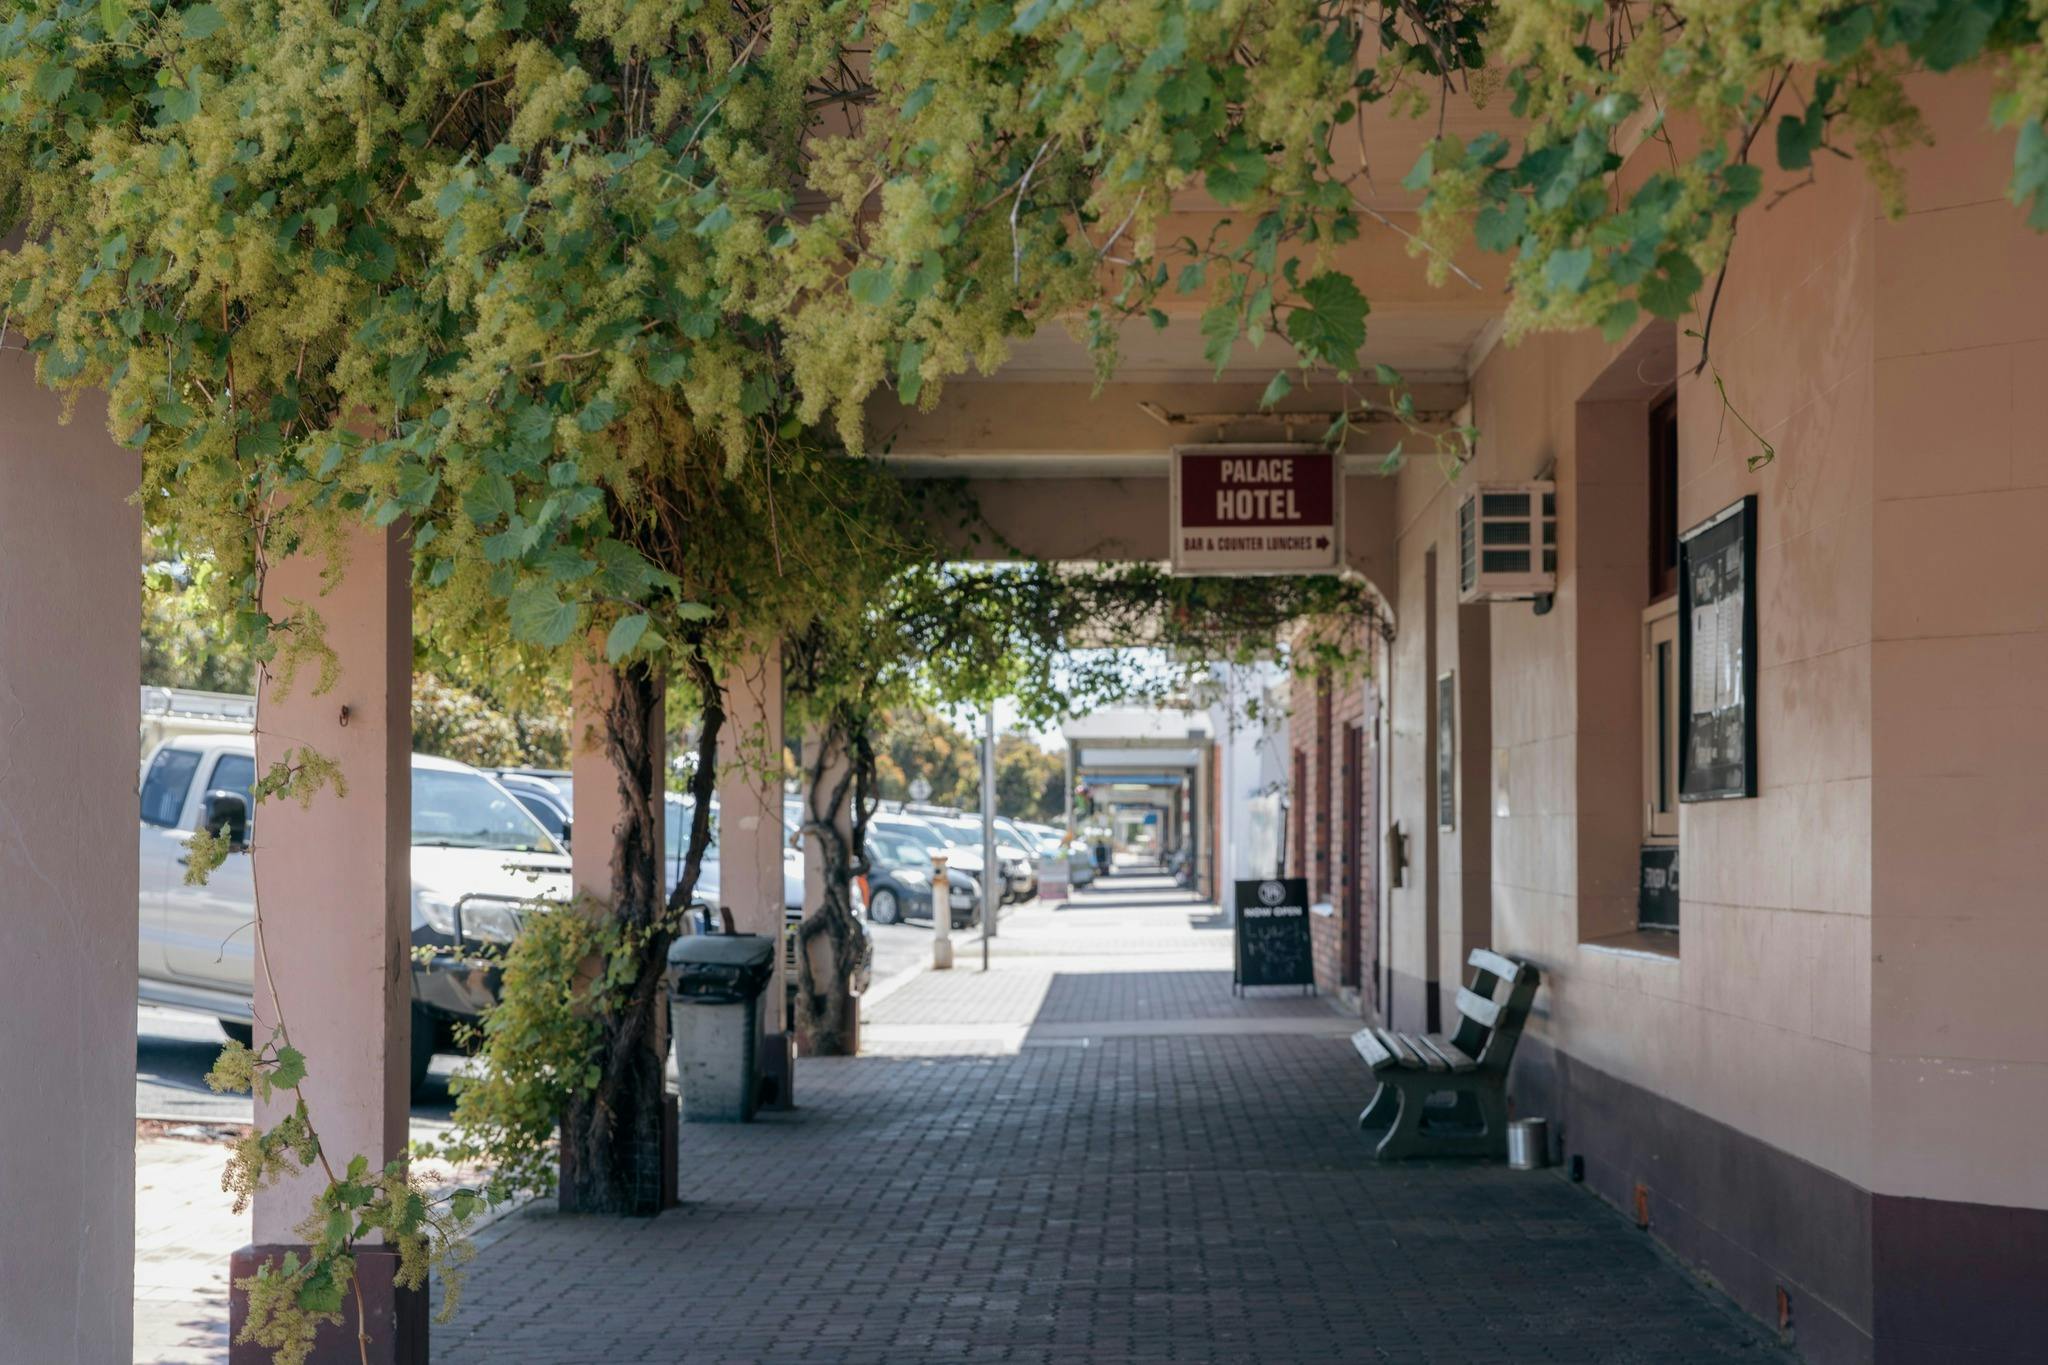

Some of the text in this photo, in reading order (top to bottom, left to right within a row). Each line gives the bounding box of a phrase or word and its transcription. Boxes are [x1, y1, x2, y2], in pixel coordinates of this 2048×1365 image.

[1220, 458, 1293, 483] PALACE
[1216, 489, 1302, 520] HOTEL
[1184, 536, 1312, 551] BAR & COUNTER LUNCHES
